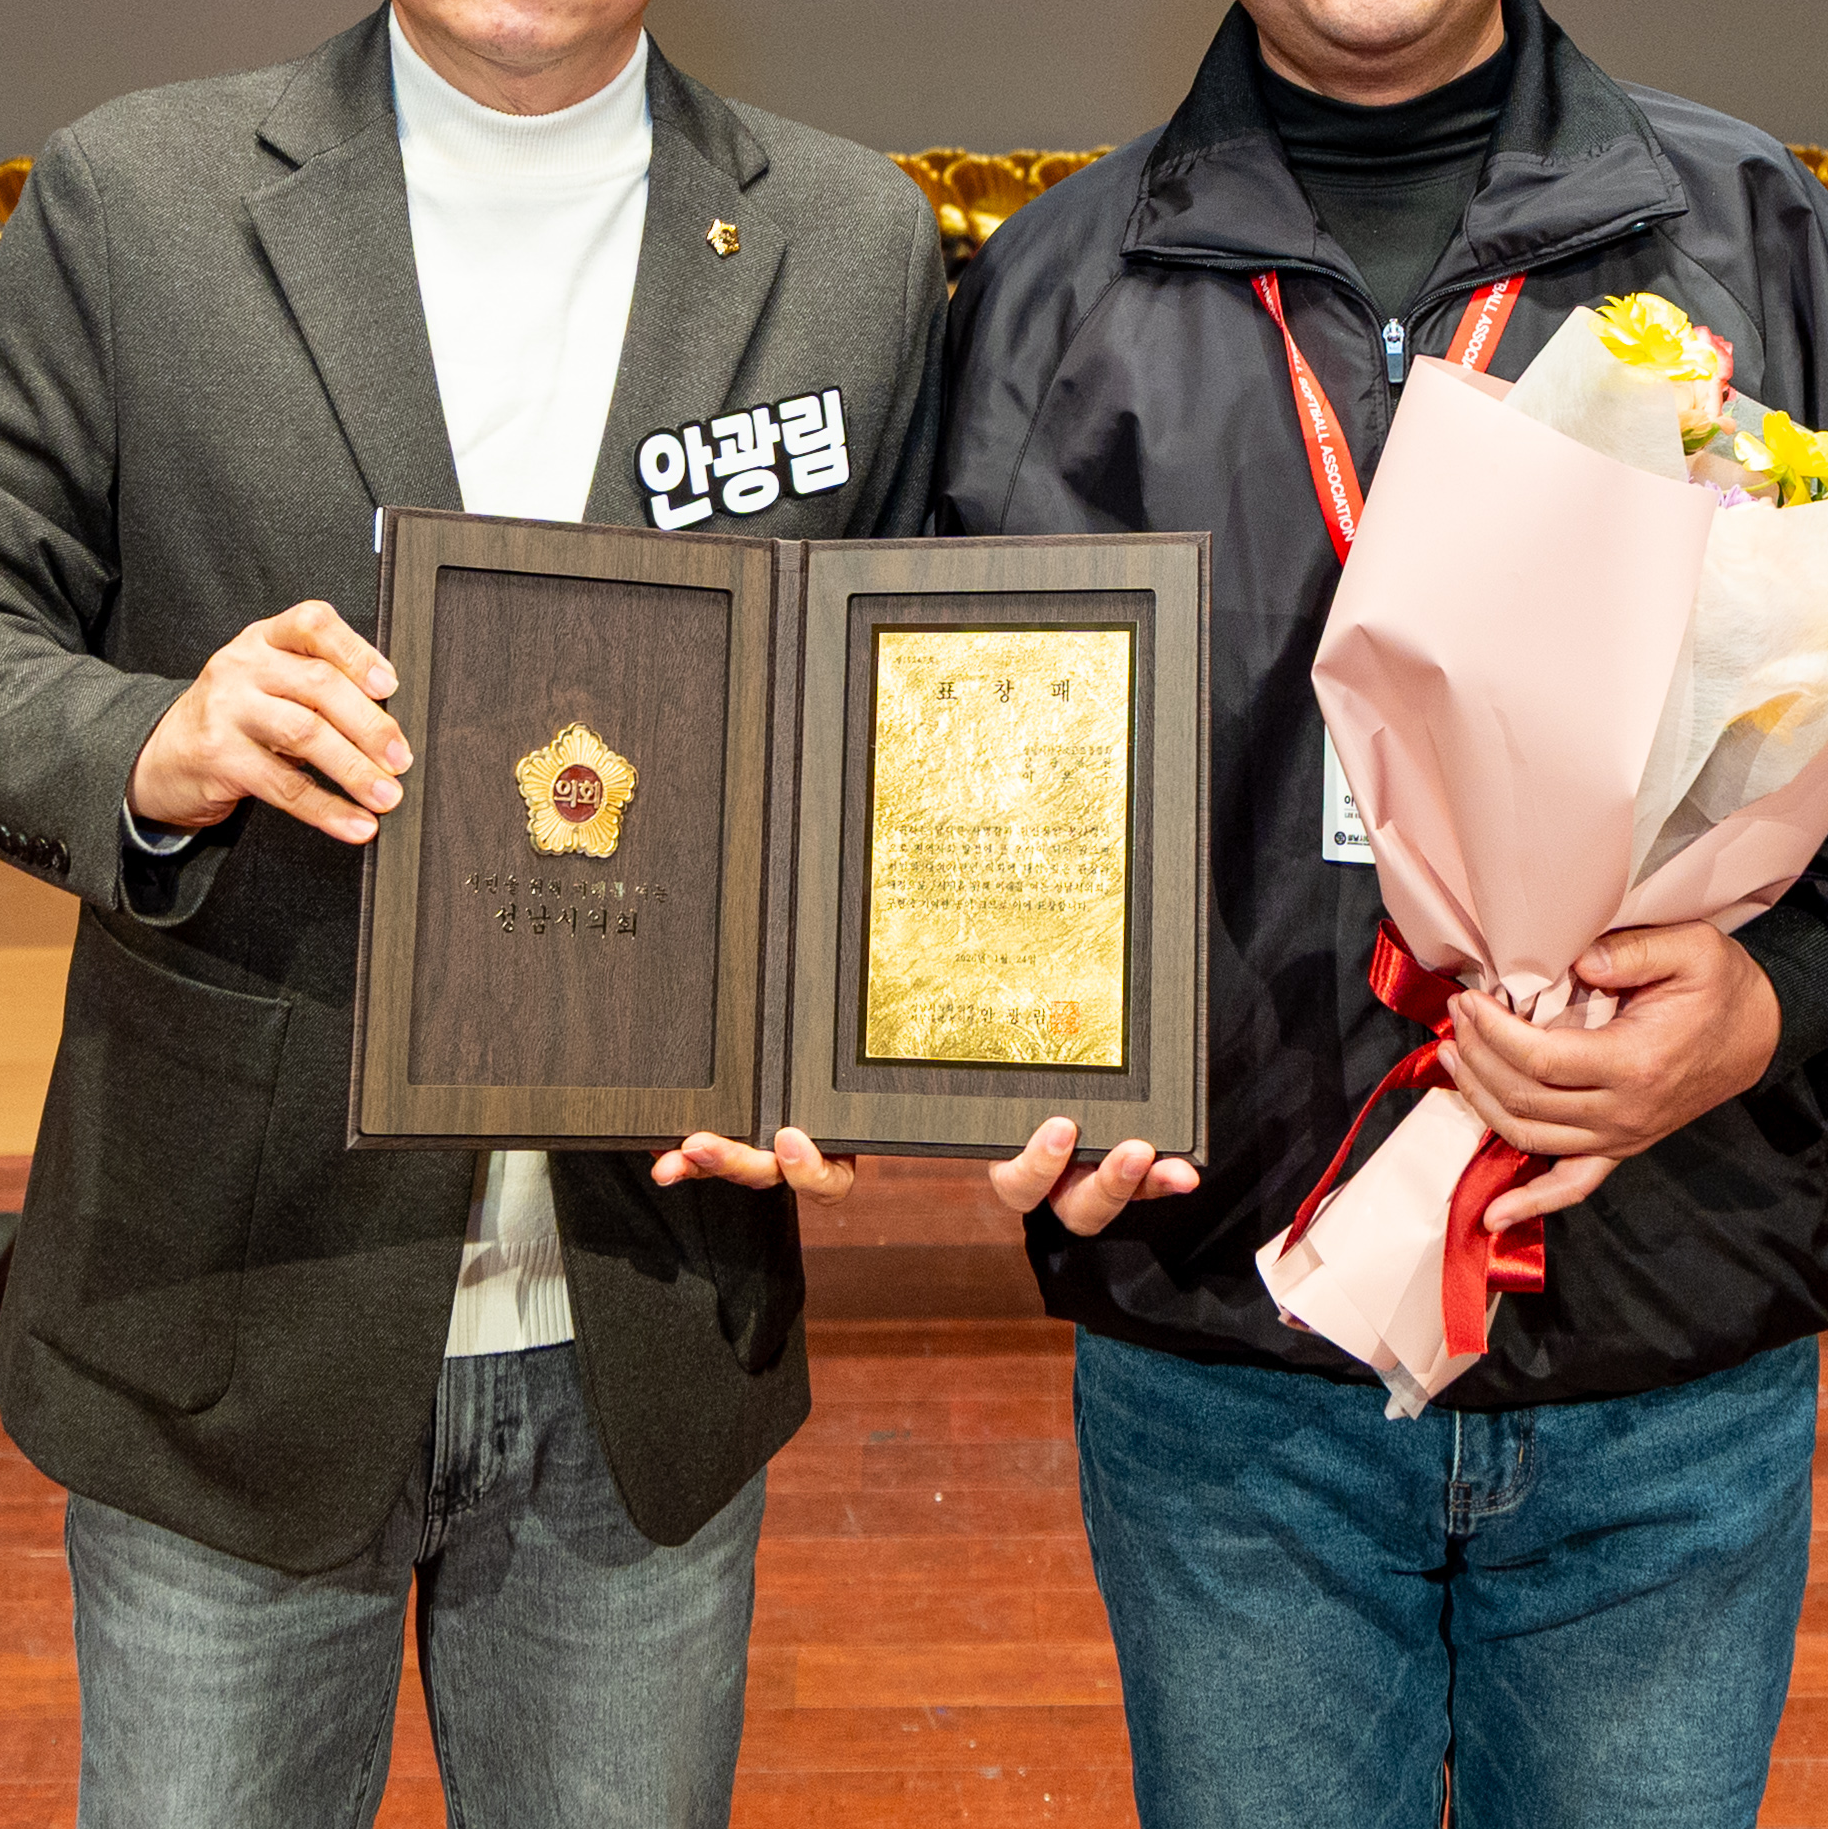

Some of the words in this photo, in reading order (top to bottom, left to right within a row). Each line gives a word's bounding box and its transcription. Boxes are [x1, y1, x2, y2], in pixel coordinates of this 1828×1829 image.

[639, 389, 850, 531] 안광림
[1298, 376, 1331, 443] SOFTBALL
[1320, 445, 1356, 543] ASSOCIATION
[553, 779, 603, 809] 의회
[493, 901, 638, 940] 성남시의회
